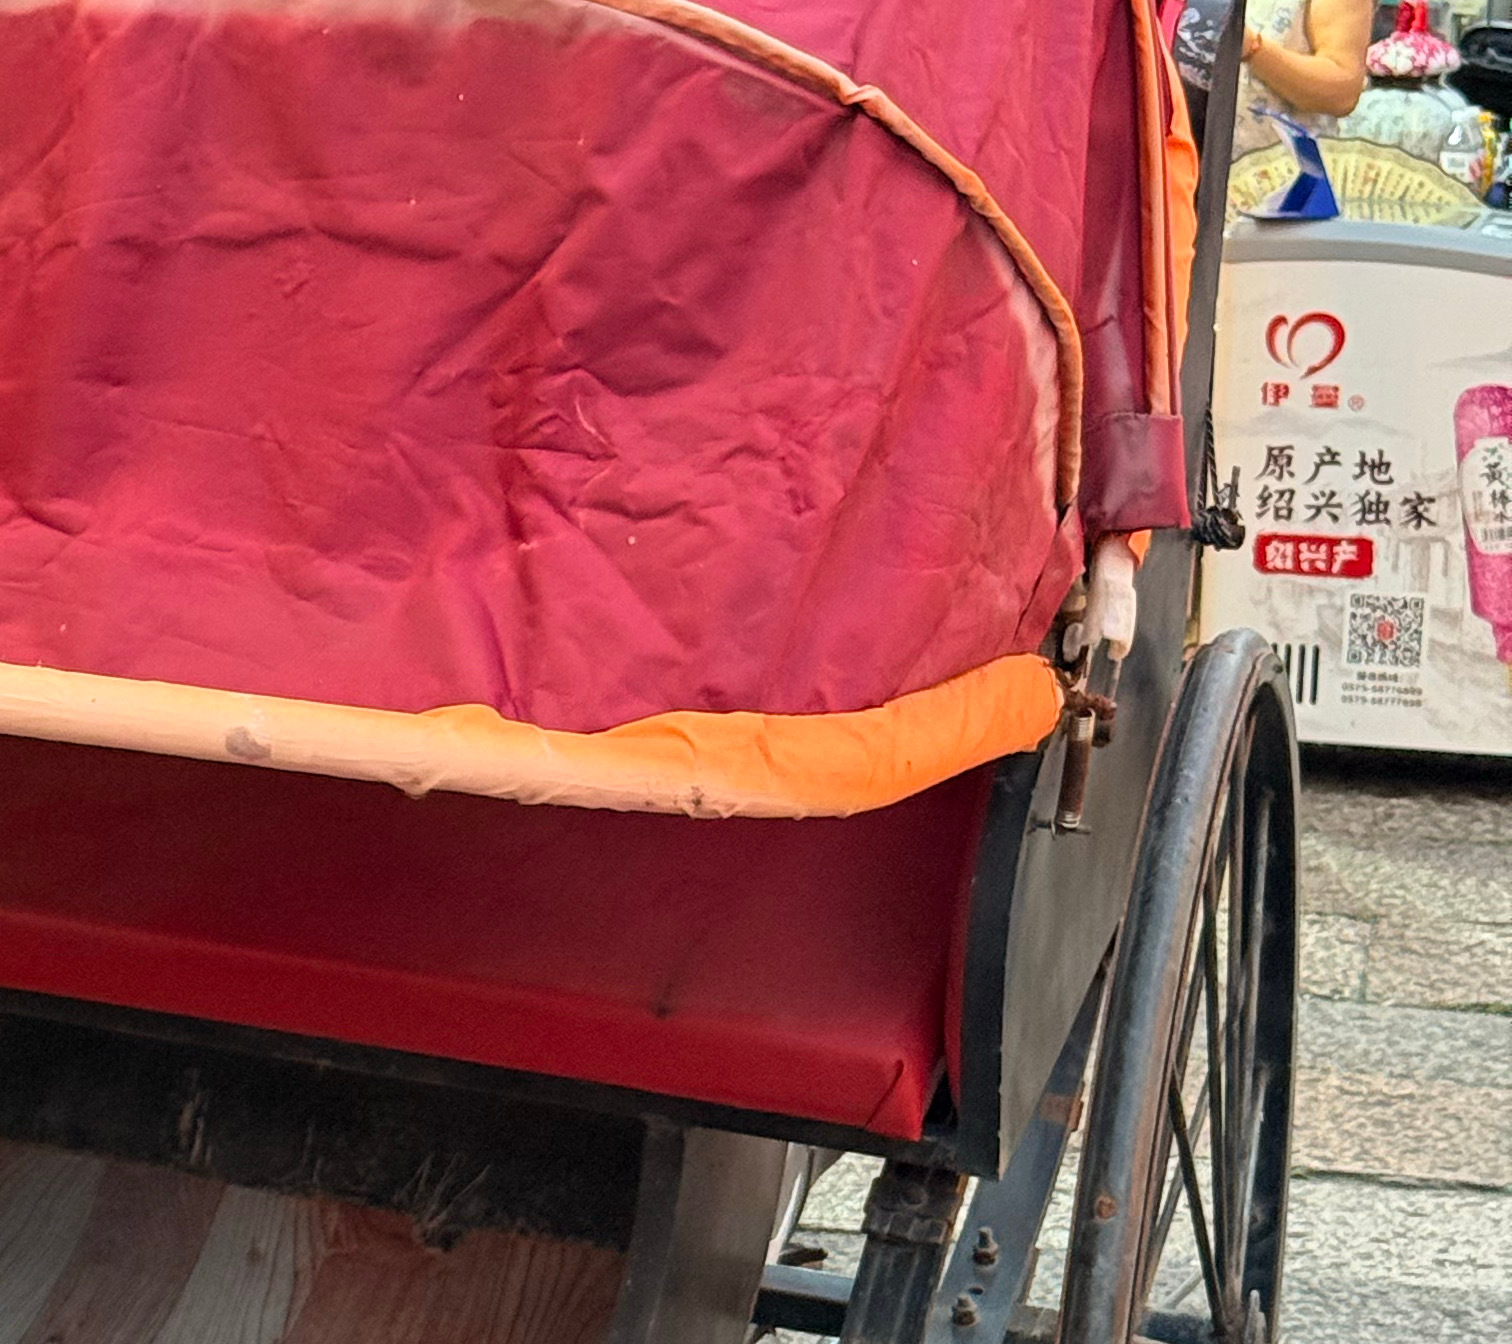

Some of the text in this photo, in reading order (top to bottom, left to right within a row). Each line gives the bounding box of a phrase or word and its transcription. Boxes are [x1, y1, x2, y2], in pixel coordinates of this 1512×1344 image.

[1255, 445, 1394, 485] 原产地
[1255, 484, 1438, 531] 绍兴独家
